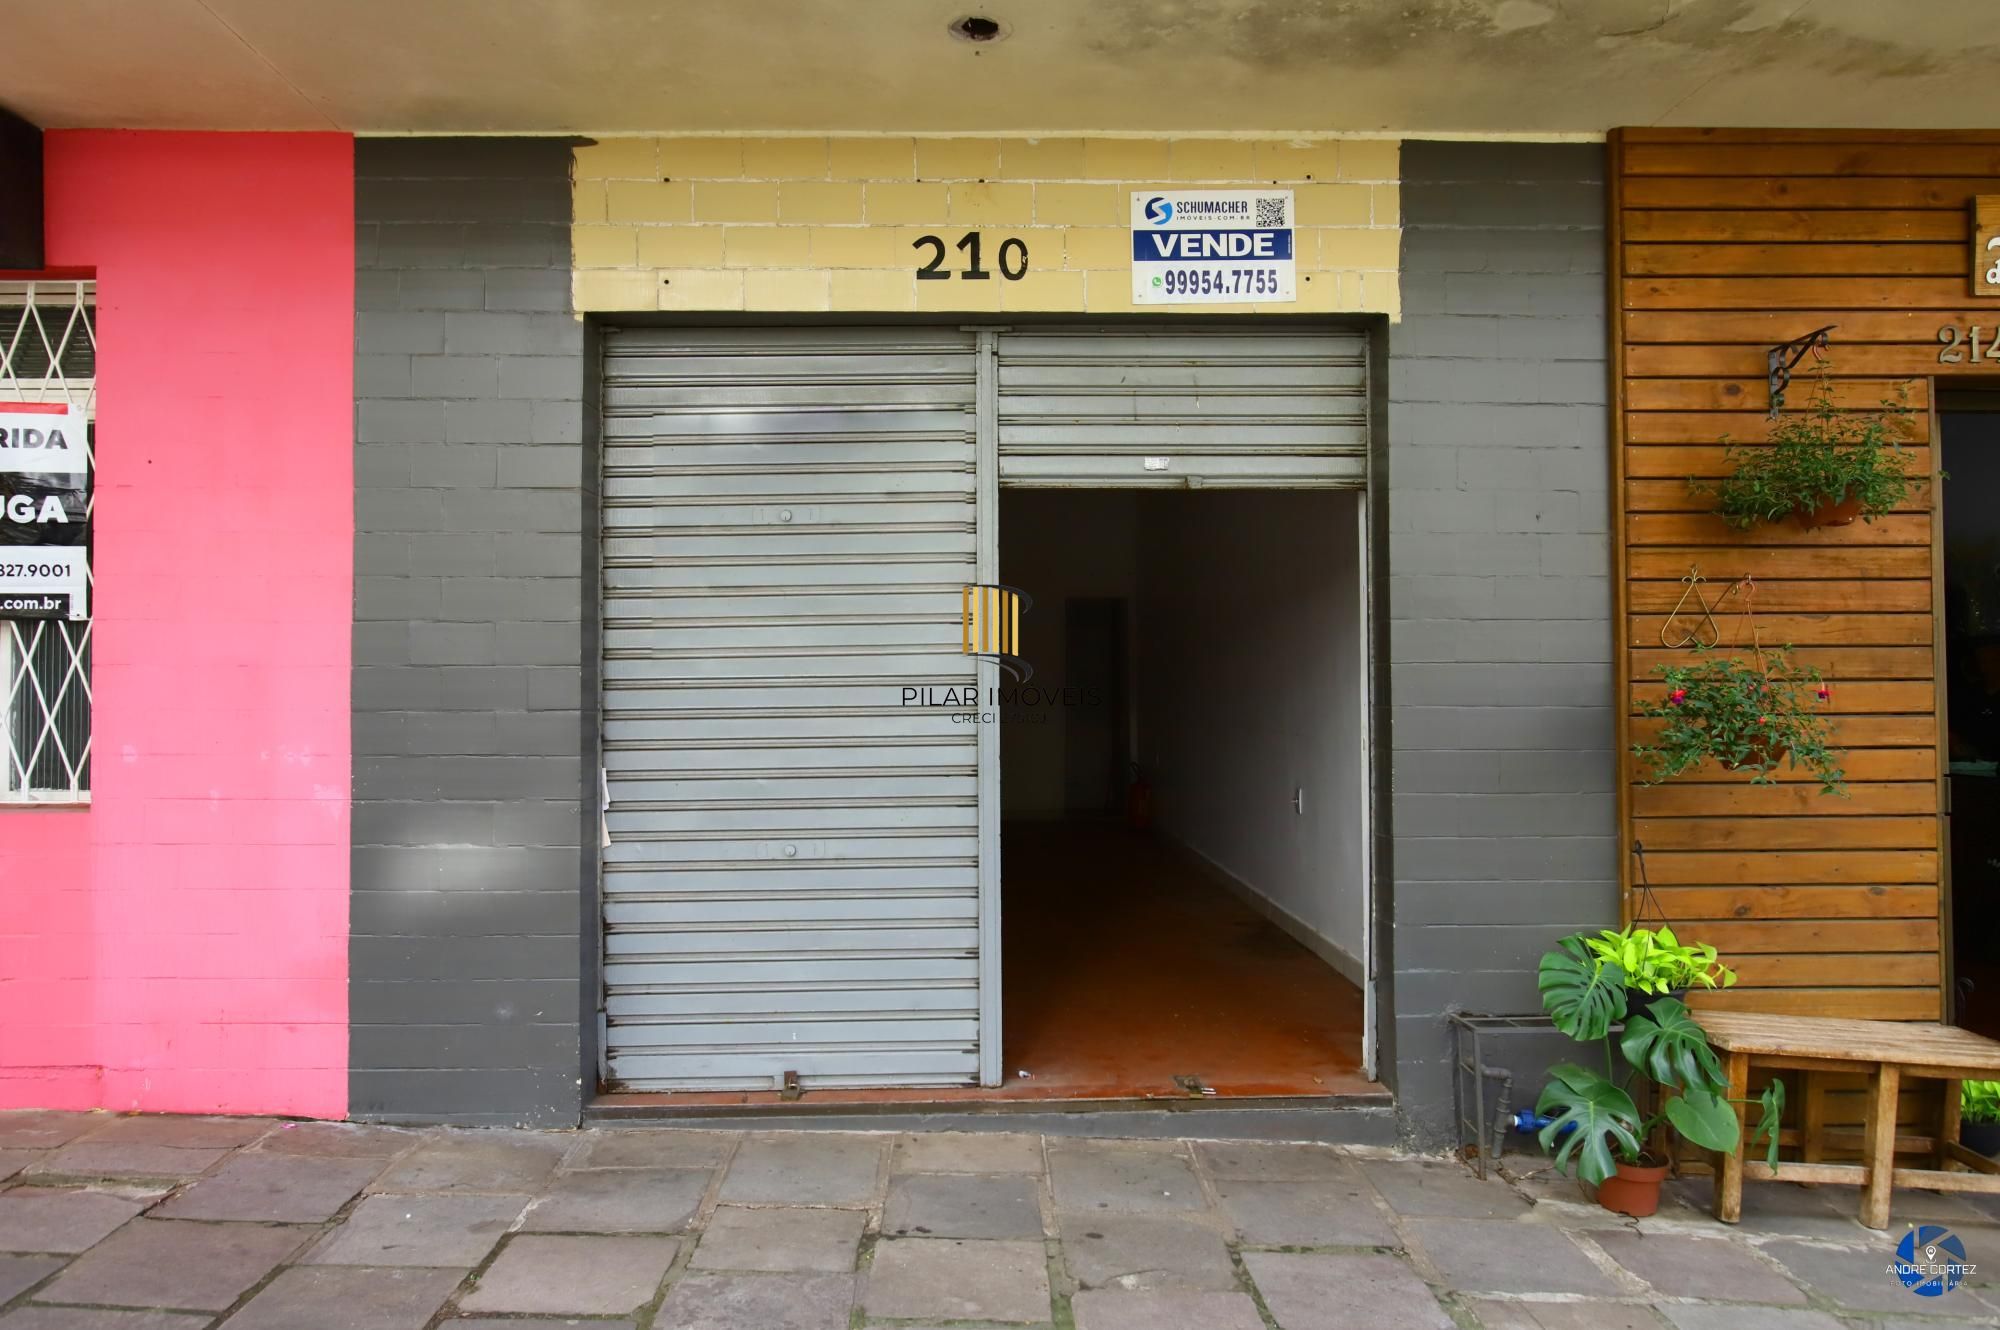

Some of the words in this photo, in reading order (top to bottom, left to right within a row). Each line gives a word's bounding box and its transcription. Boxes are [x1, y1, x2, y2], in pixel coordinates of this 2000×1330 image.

[1176, 201, 1248, 213] SCHUMACHER
[912, 231, 1029, 281] 210
[1151, 233, 1275, 257] VENDE
[1165, 269, 1278, 295] 99954.7755
[1937, 325, 2000, 364] 214
[0, 494, 69, 524] GA
